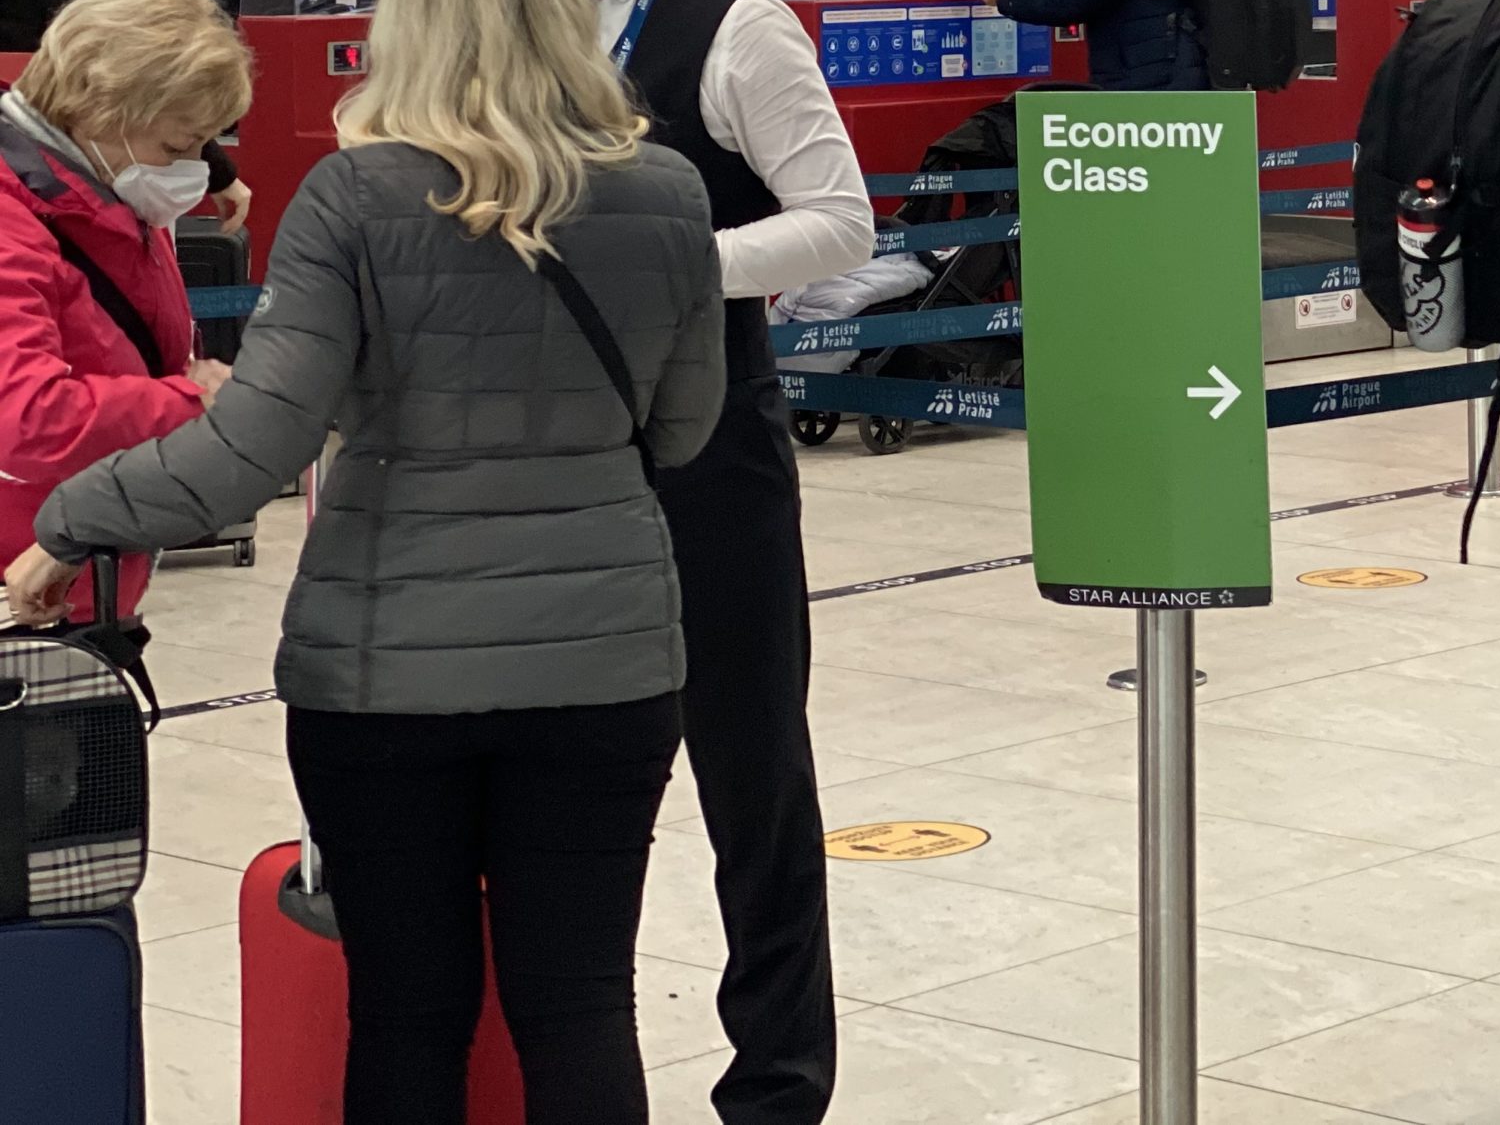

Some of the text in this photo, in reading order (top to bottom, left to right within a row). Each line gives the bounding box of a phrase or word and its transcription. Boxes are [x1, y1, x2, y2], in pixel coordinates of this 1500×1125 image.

[1042, 114, 1223, 155] Economy
[928, 174, 953, 182] Prague
[1042, 158, 1149, 193] Class
[928, 182, 953, 191] Airport
[1325, 190, 1349, 200] Letiště
[1325, 199, 1346, 208] Praha
[874, 231, 905, 242] Prague
[874, 240, 905, 252] Airport
[1343, 266, 1360, 275] Pra
[1343, 276, 1361, 286] Airp
[823, 324, 861, 337] Letiště
[822, 336, 853, 348] Praha
[1342, 381, 1380, 396] Prague
[958, 390, 1000, 406] Letiště
[1341, 393, 1381, 409] Airport
[958, 404, 993, 419] Praha
[962, 558, 1021, 571] STOP
[855, 576, 916, 591] STOP
[1068, 587, 1212, 607] STAR ALLIANCE
